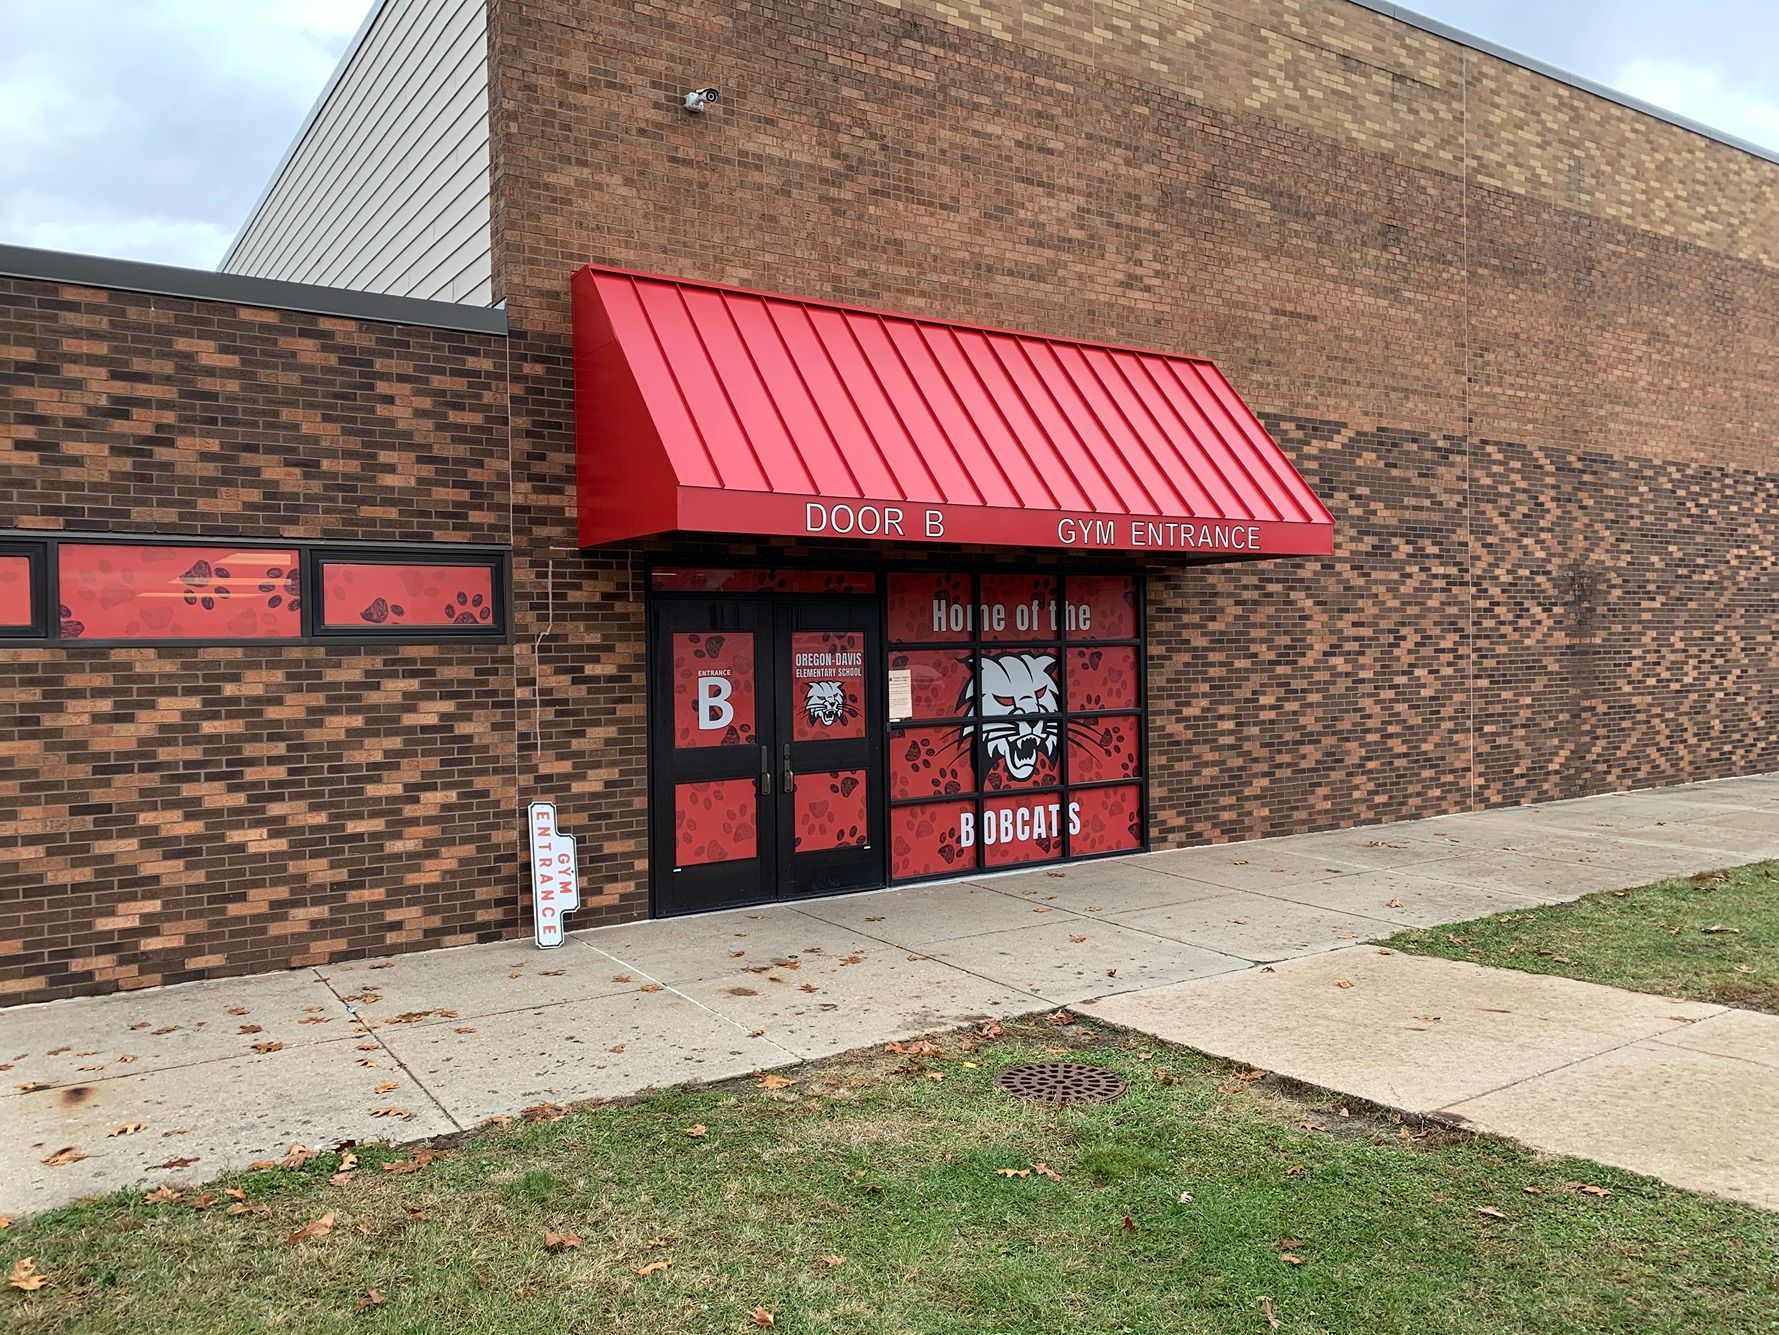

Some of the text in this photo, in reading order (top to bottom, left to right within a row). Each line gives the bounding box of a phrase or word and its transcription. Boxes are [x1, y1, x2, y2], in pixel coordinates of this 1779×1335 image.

[805, 502, 945, 538] DOOR B
[1057, 518, 1261, 550] GYM ENTRANCE
[932, 599, 1091, 632] Home of the
[698, 669, 731, 677] ENTRANCE
[795, 652, 862, 667] OREGON-DAVIS
[796, 667, 862, 678] ELEMENTARY SCHOOL
[698, 676, 734, 730] B
[960, 802, 1081, 847] BOBCATS
[535, 811, 557, 935] ENTRANCE
[557, 853, 573, 894] GYM
